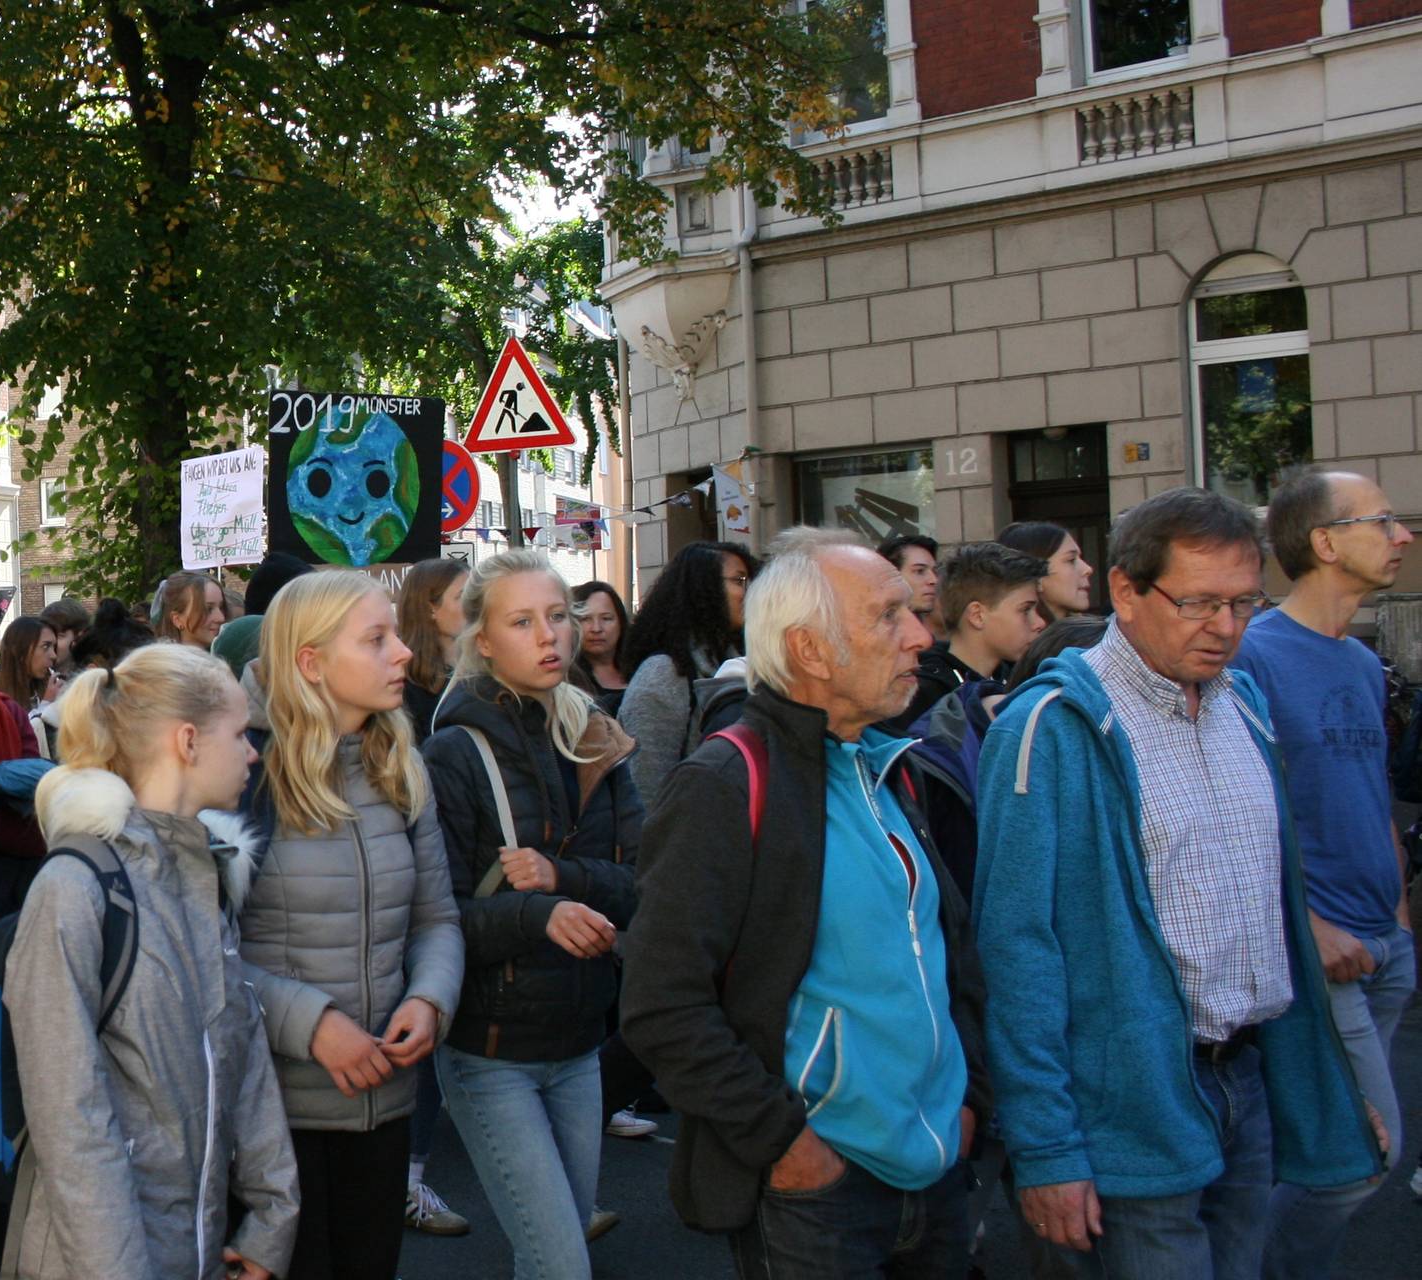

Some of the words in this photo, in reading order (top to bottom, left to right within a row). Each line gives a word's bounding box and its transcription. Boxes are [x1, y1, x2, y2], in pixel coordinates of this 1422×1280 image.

[269, 392, 354, 433] 2019
[355, 396, 421, 416] MÜNSTER
[945, 447, 979, 476] 12
